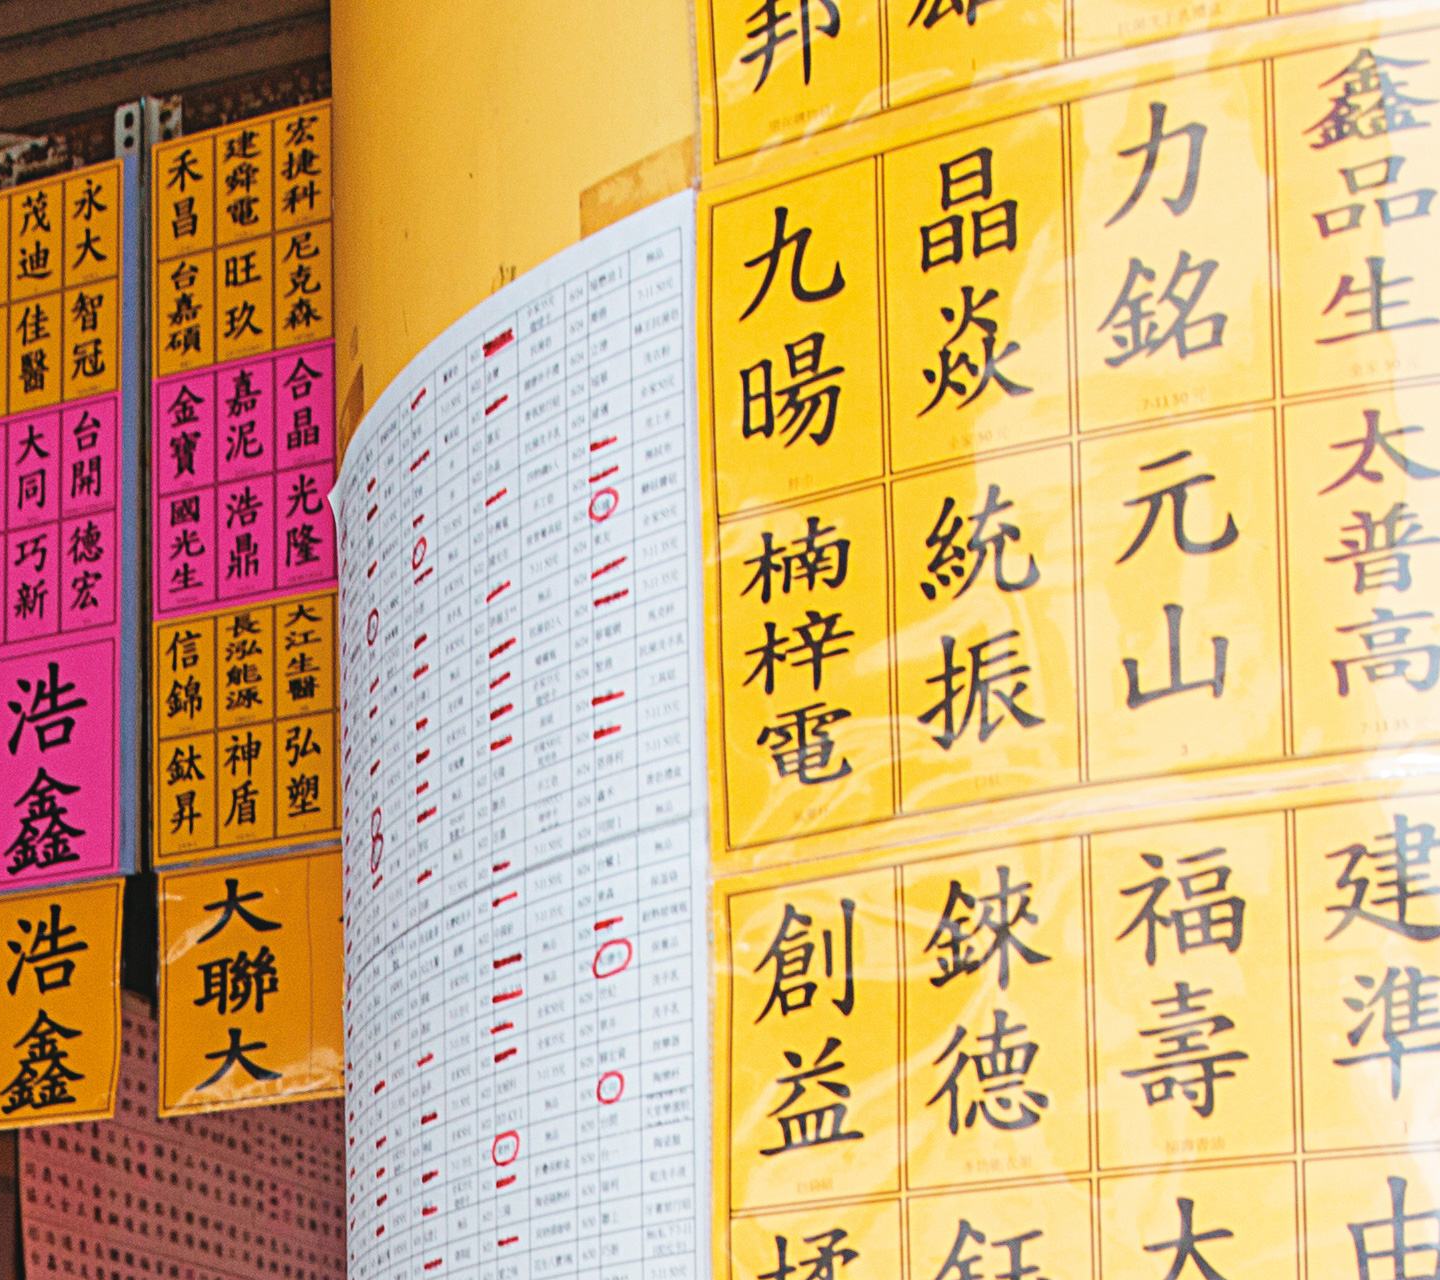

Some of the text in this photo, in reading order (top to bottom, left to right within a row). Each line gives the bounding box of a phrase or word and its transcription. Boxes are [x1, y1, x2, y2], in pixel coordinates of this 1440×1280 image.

[167, 149, 203, 240] 禾昌
[281, 116, 321, 214] 宏捷科
[1100, 101, 1227, 370] 力銘
[1304, 48, 1440, 346] 鑫品生
[224, 251, 263, 340] 旺玖
[281, 232, 321, 332] 尼克森
[737, 205, 845, 449] 九暘
[919, 146, 1033, 418] 晶焱
[167, 385, 204, 479] 金寶
[225, 369, 263, 461] 嘉泥
[283, 357, 323, 451] 合晶
[14, 534, 48, 619] 巧新
[68, 521, 104, 611] 德宏
[168, 496, 204, 593] 國光生
[225, 487, 263, 580] 浩鼎
[285, 474, 323, 568] 光隆
[917, 483, 1046, 751] 統振
[1120, 447, 1239, 710] 元山
[742, 516, 856, 786] 楠梓電
[4, 662, 88, 876] 浩鑫
[0, 904, 89, 1115] 浩鑫
[194, 878, 282, 1091] 大聯大
[754, 897, 864, 1158] 創益
[922, 865, 1052, 1137] 錸德
[1115, 848, 1249, 1118] 福壽
